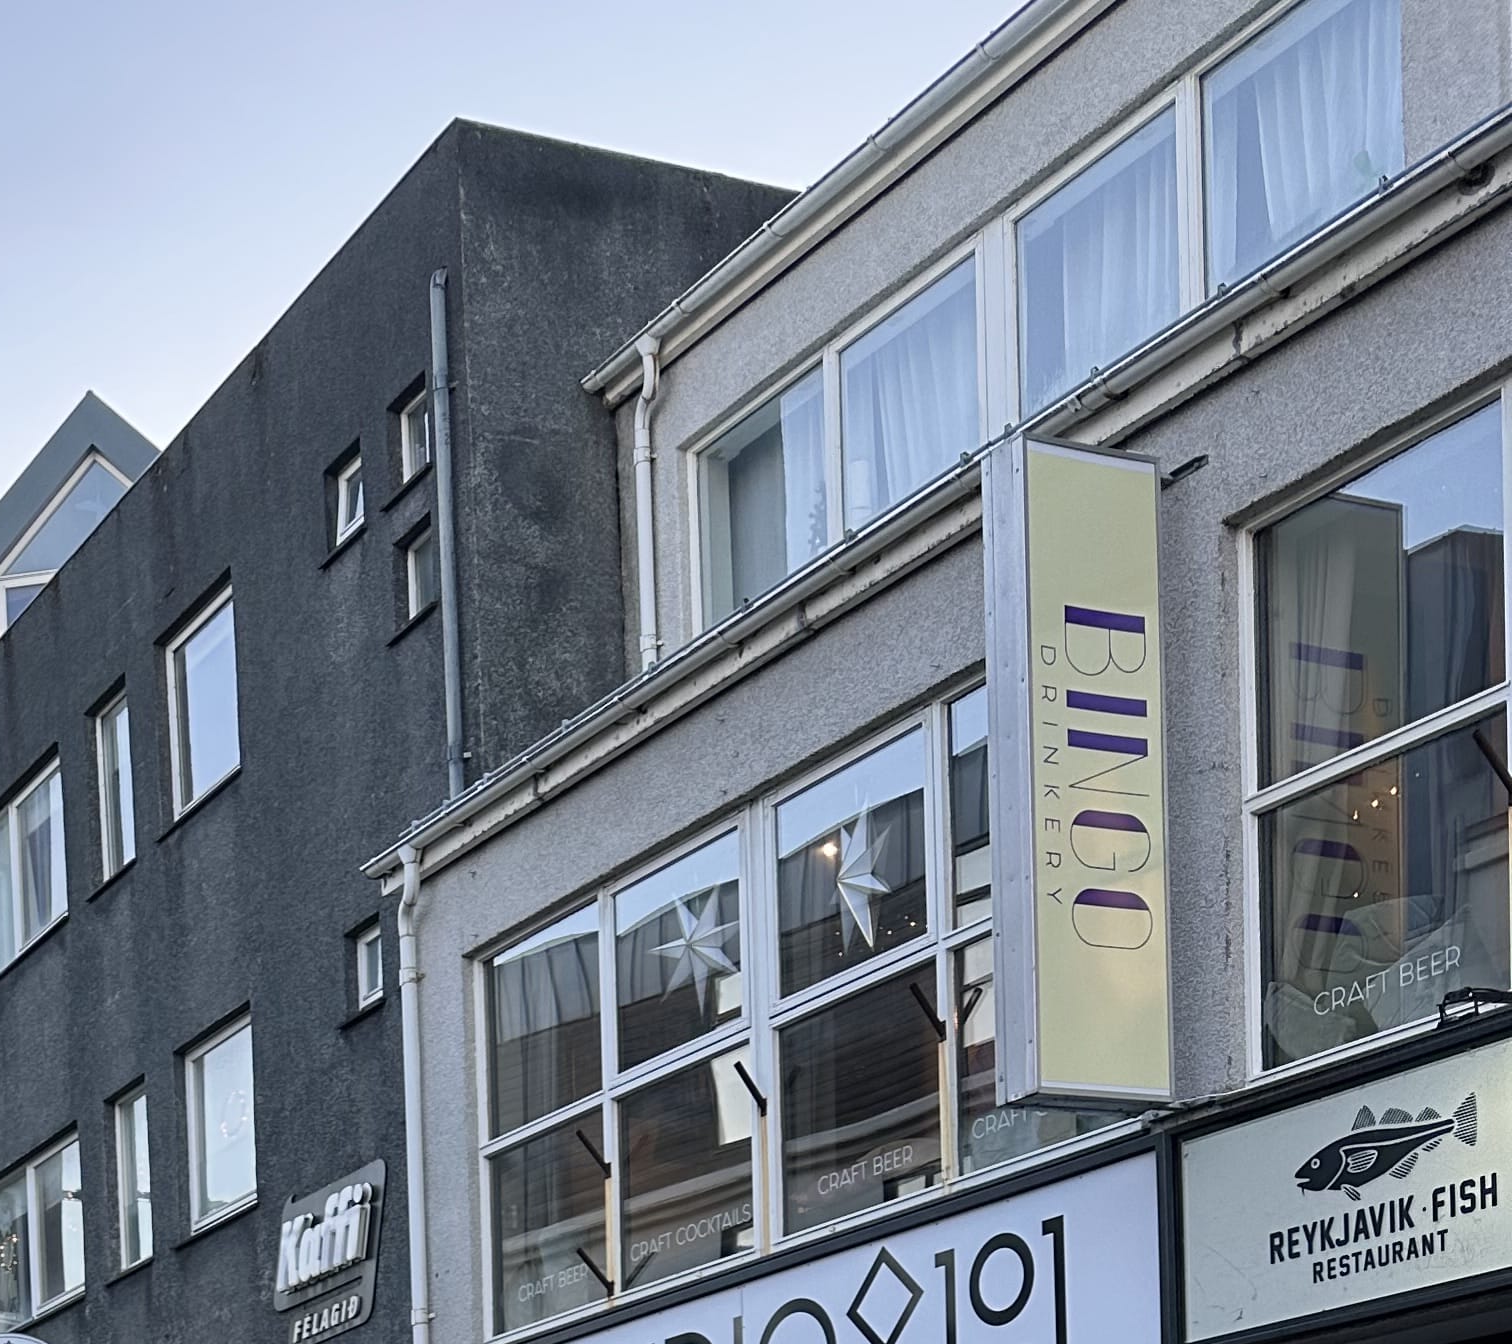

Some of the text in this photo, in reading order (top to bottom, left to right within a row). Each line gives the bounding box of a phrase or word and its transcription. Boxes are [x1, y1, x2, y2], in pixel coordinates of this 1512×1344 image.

[1039, 644, 1063, 905] DRINKERY
[1064, 604, 1153, 951] BINGO
[1313, 944, 1461, 1016] CRAFT BEER
[817, 1144, 914, 1196] CRAFT BEER
[276, 1182, 372, 1295] Kaffi
[630, 1202, 752, 1263] CRAFT COCKTAILS
[1269, 1172, 1498, 1265] REYKJAVIK FISH
[518, 1261, 589, 1302] CRAFT BEER
[1312, 1228, 1449, 1284] RESTAURANT
